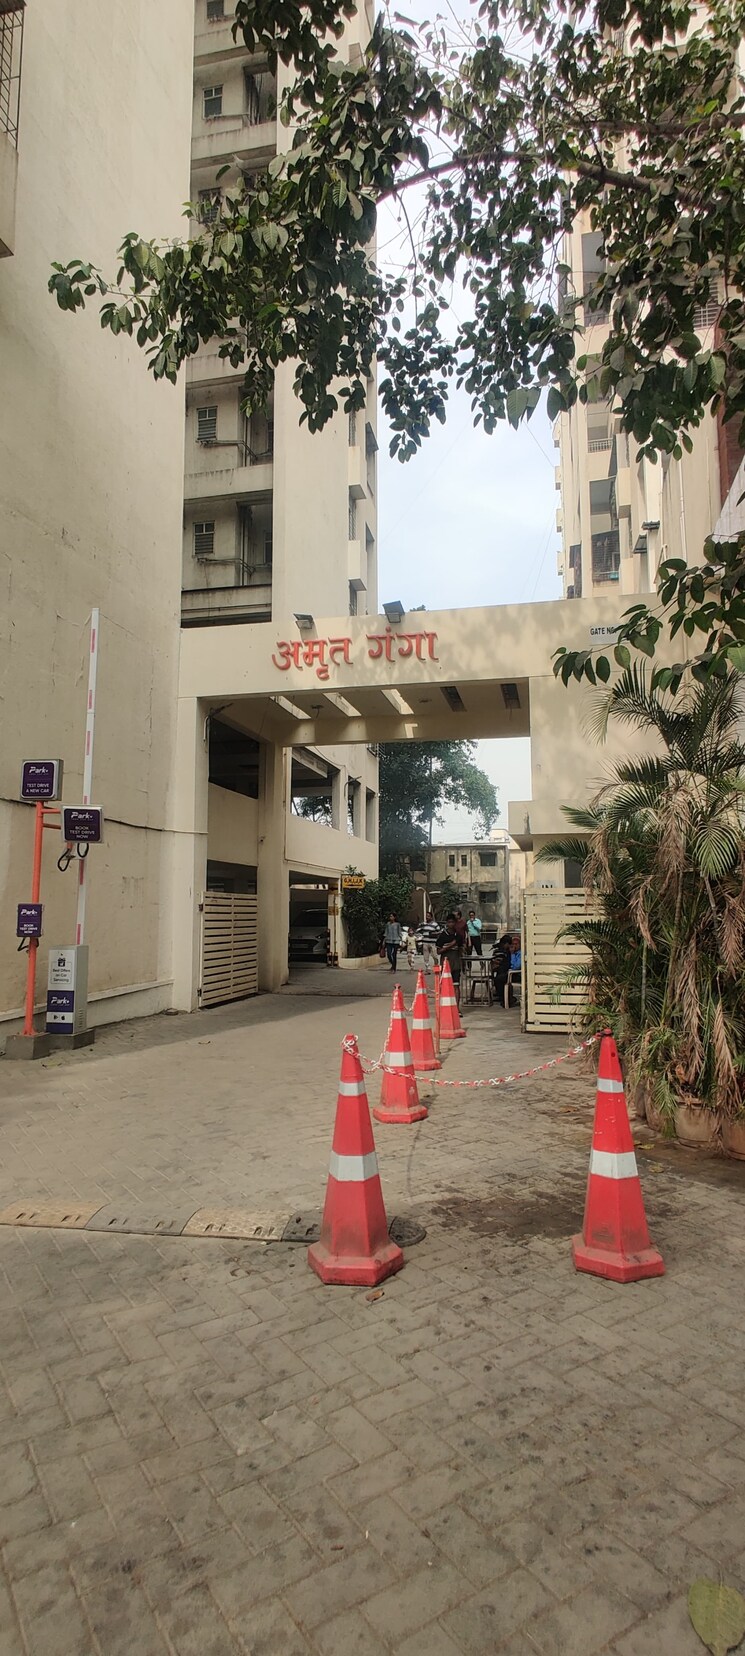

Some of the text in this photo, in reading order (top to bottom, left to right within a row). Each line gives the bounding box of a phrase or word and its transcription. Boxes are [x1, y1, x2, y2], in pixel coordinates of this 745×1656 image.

[590, 627, 605, 635] GATE
[272, 626, 439, 680] अमृत गंगा
